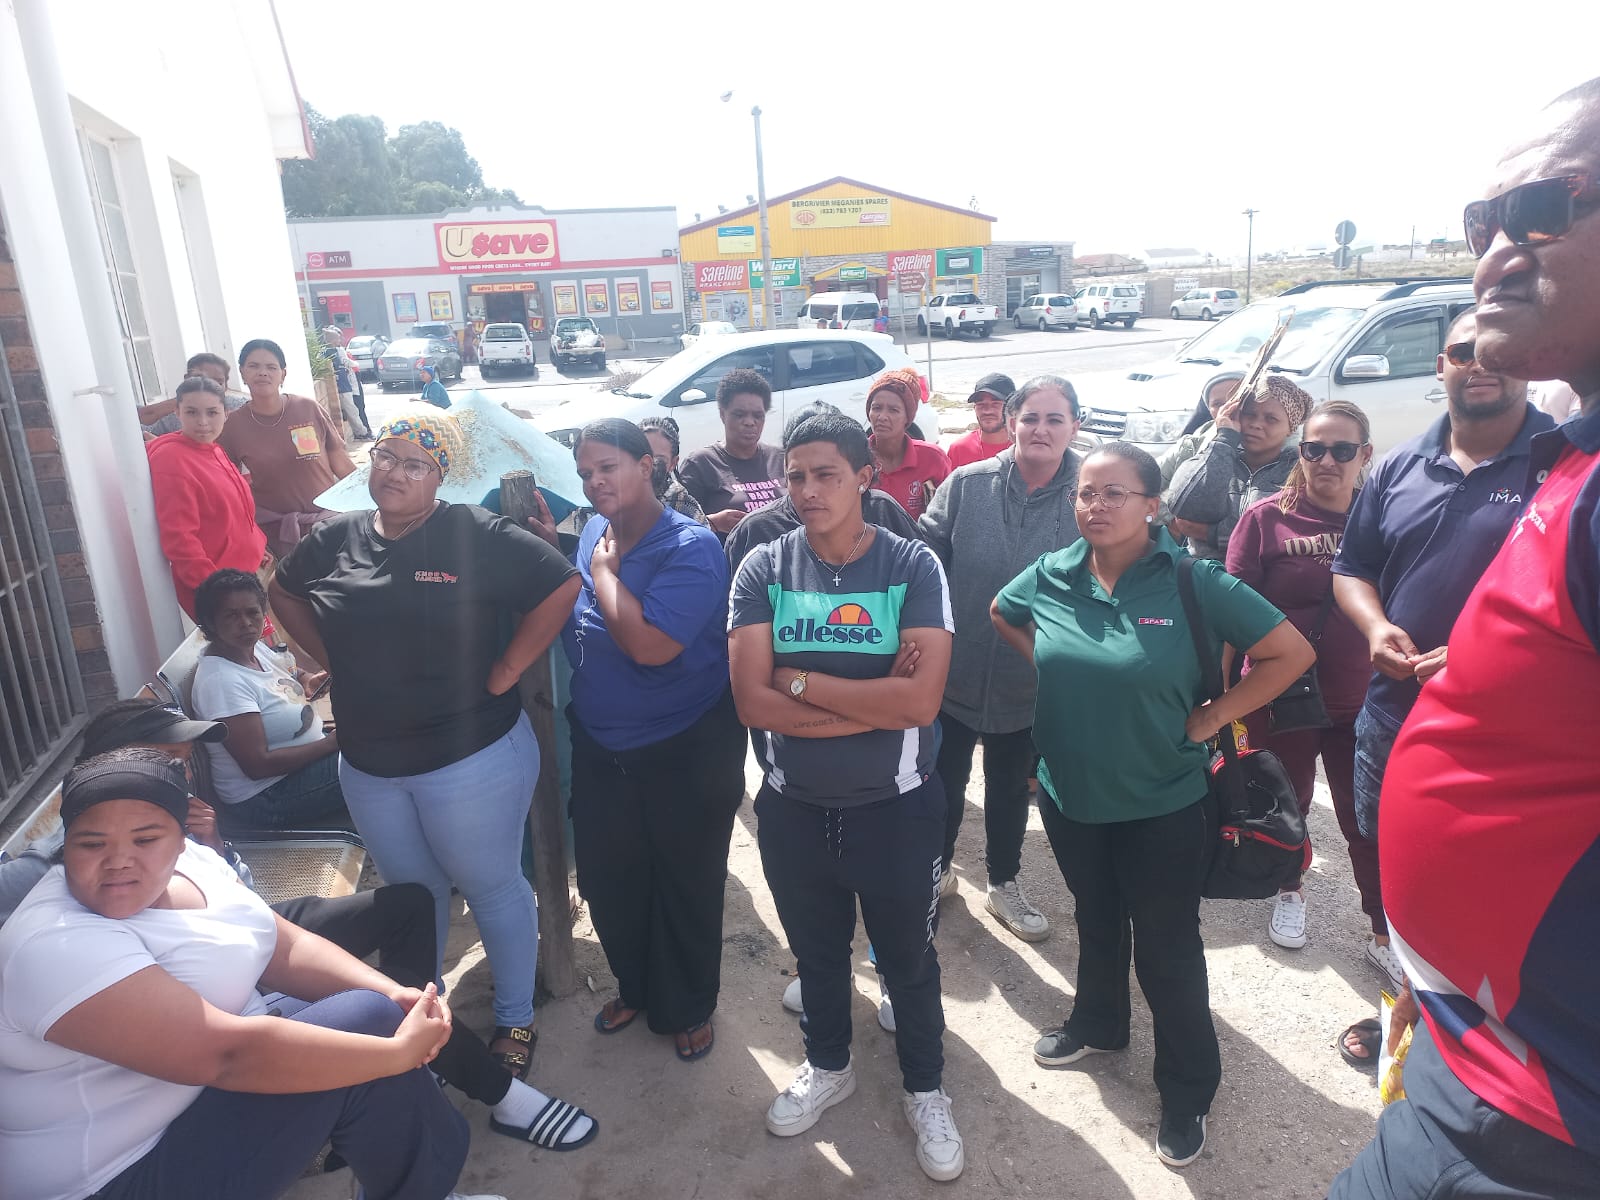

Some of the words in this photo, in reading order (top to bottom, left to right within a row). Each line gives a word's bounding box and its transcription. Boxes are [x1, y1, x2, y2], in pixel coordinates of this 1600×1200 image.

[329, 256, 347, 264] ATM
[751, 260, 796, 272] Wlard
[1283, 533, 1343, 556] IDEN
[778, 618, 883, 644] ellesse
